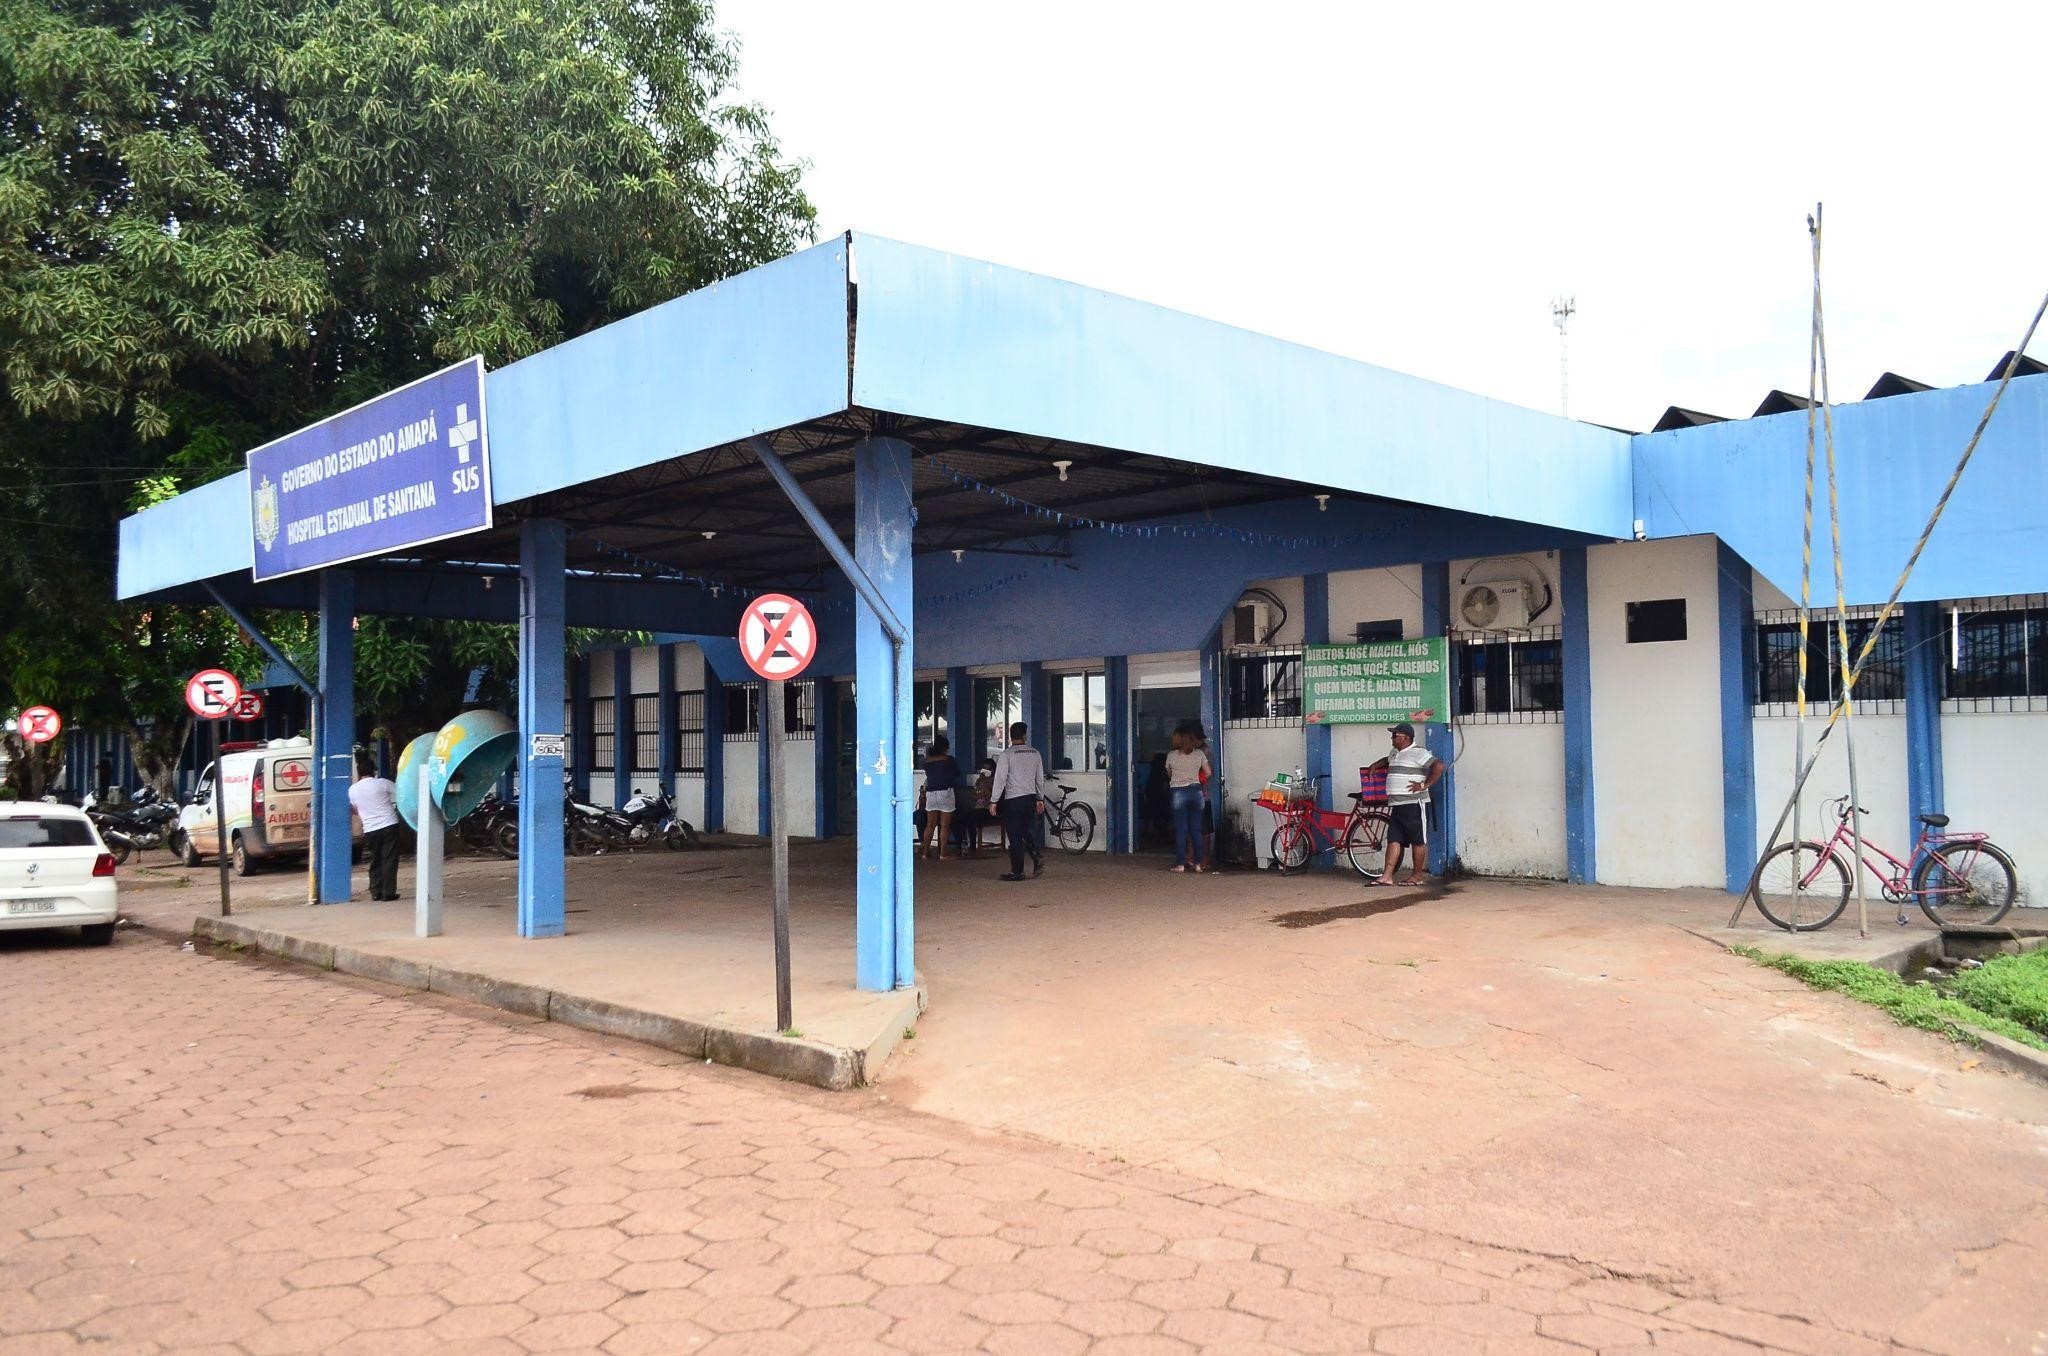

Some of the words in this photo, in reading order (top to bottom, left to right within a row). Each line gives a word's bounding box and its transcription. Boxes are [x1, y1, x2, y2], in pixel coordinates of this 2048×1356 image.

[282, 461, 323, 493] GOVERNO
[324, 454, 339, 482] DO
[339, 439, 377, 474] ESTADO
[379, 433, 394, 461] DO
[397, 410, 437, 453] AMAPÁ
[452, 466, 480, 495] SUS
[287, 510, 326, 545] HOSPITAL
[327, 501, 371, 535] ESTADUAL
[373, 495, 387, 520] DE
[387, 480, 436, 517] SANTANA
[1306, 648, 1345, 661] DIRETOR
[1345, 645, 1367, 659] JOSÉ
[1369, 645, 1407, 659] MACIEL,
[1408, 641, 1429, 656] NÓS
[1304, 665, 1339, 678] STAMOS
[1340, 664, 1362, 676] COM
[1392, 660, 1440, 674] SABEMOS
[203, 680, 224, 706] E
[1314, 681, 1339, 695] QUEM
[1341, 679, 1366, 693] VOCÊ
[1376, 679, 1402, 692] NADA
[1404, 679, 1420, 692] VAI
[1314, 698, 1355, 711] DIFAMAR
[1356, 697, 1377, 710] SUA
[1378, 696, 1420, 709] IMAGEM!
[1329, 714, 1375, 722] SERVIDORES
[1390, 713, 1406, 721] HES
